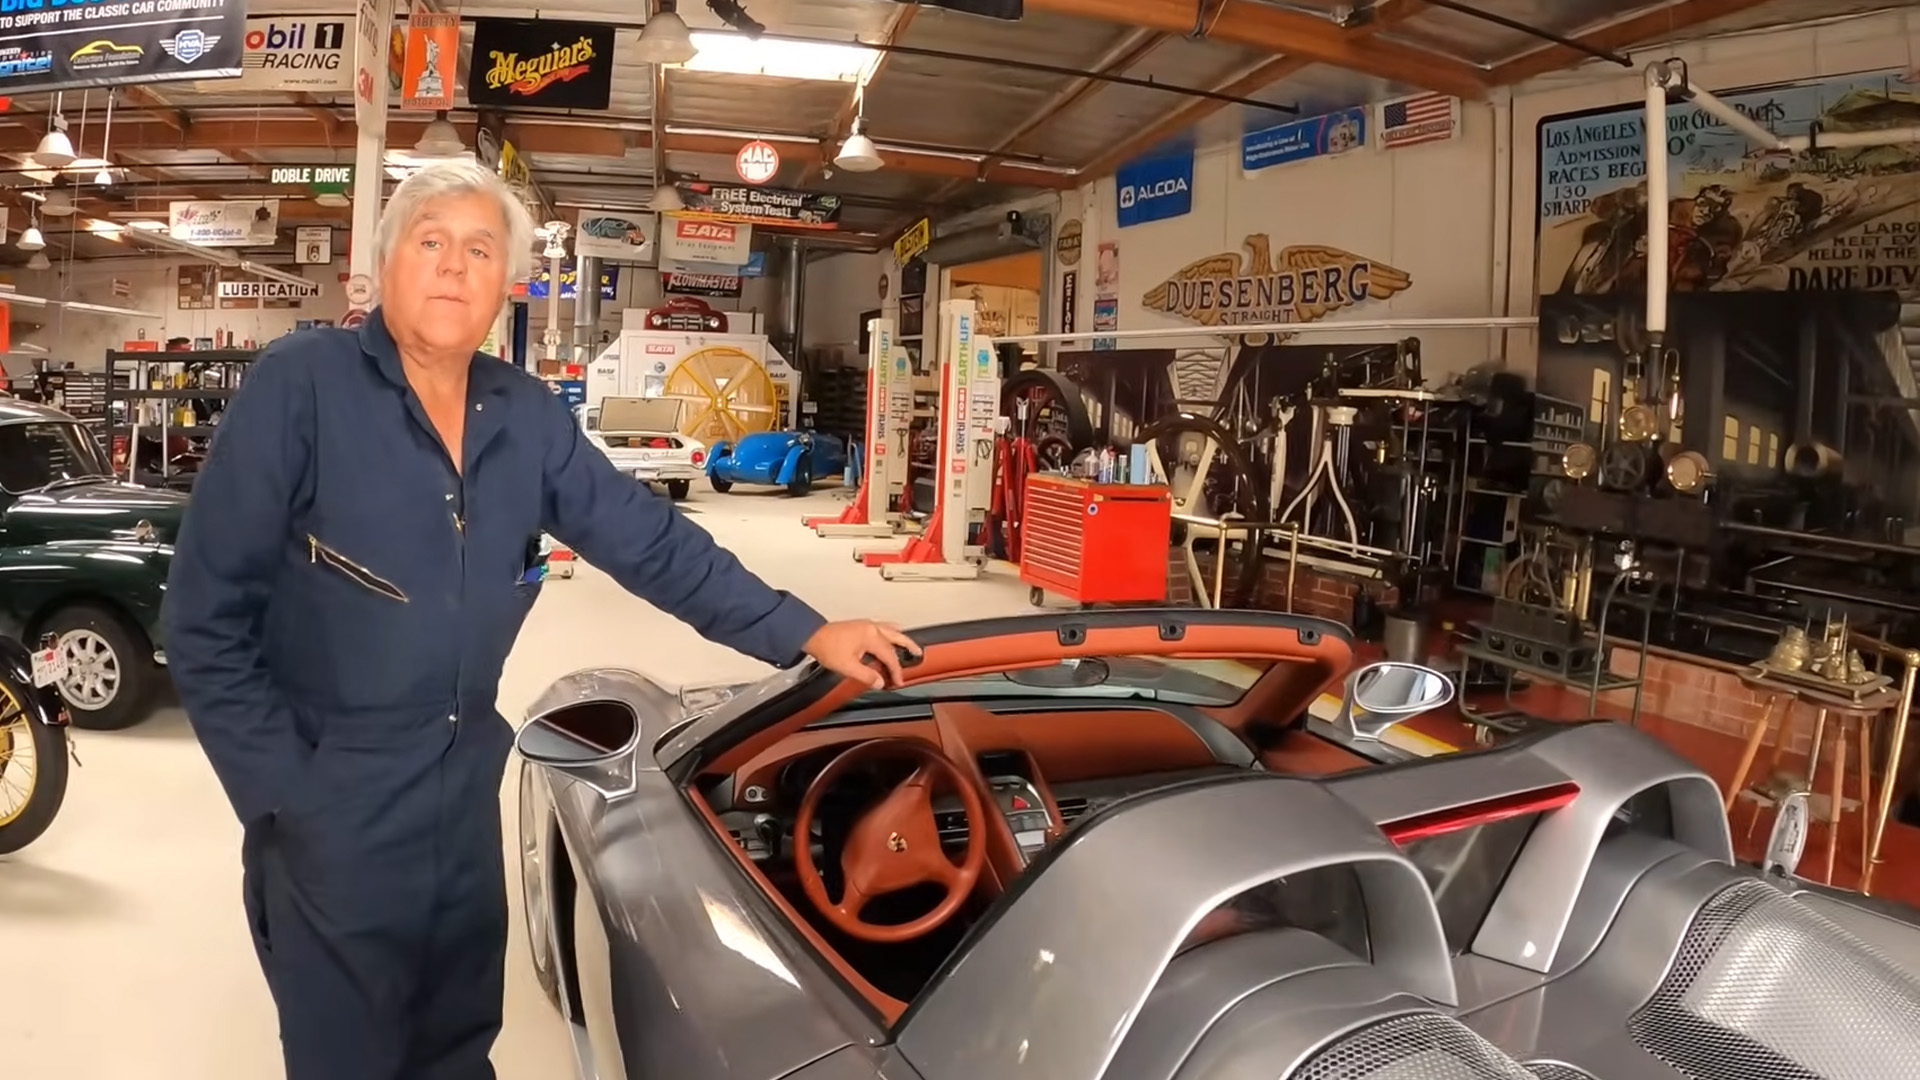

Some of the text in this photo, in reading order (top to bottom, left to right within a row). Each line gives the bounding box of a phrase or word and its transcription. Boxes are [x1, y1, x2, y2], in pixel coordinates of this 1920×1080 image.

[0, 17, 13, 29] TO
[15, 11, 61, 28] SUPPORT
[63, 8, 83, 22] THE
[84, 3, 130, 19] CLASSIC
[132, 1, 155, 15] CAR
[157, 0, 225, 12] COMMUNITY
[245, 23, 306, 50] obil
[262, 53, 341, 69] RACING
[485, 36, 594, 89] Meguiar's
[1546, 128, 1571, 148] LOS
[1572, 121, 1637, 145] ANGELES
[1556, 144, 1641, 166] ADMISSION
[271, 168, 350, 183] DOBLE DRIVE
[1549, 161, 1646, 185] RACES BEGI
[712, 188, 747, 202] FREE
[749, 191, 802, 207] Electrical
[1137, 177, 1188, 201] ALCOA
[721, 202, 792, 218] System Test!
[681, 223, 732, 239] SATA
[1864, 222, 1920, 235] LARG
[1891, 235, 1920, 246] EV
[1808, 247, 1917, 261] HELD IN THE
[1166, 262, 1370, 312] DUESENBERG
[1866, 264, 1920, 288] DEV
[222, 284, 319, 296] LUBRICATION
[1219, 308, 1294, 326] STRAIGHT
[879, 330, 889, 386] EARTHLIFT
[958, 315, 969, 387] EARTHLIFT
[956, 422, 967, 454] stertil
